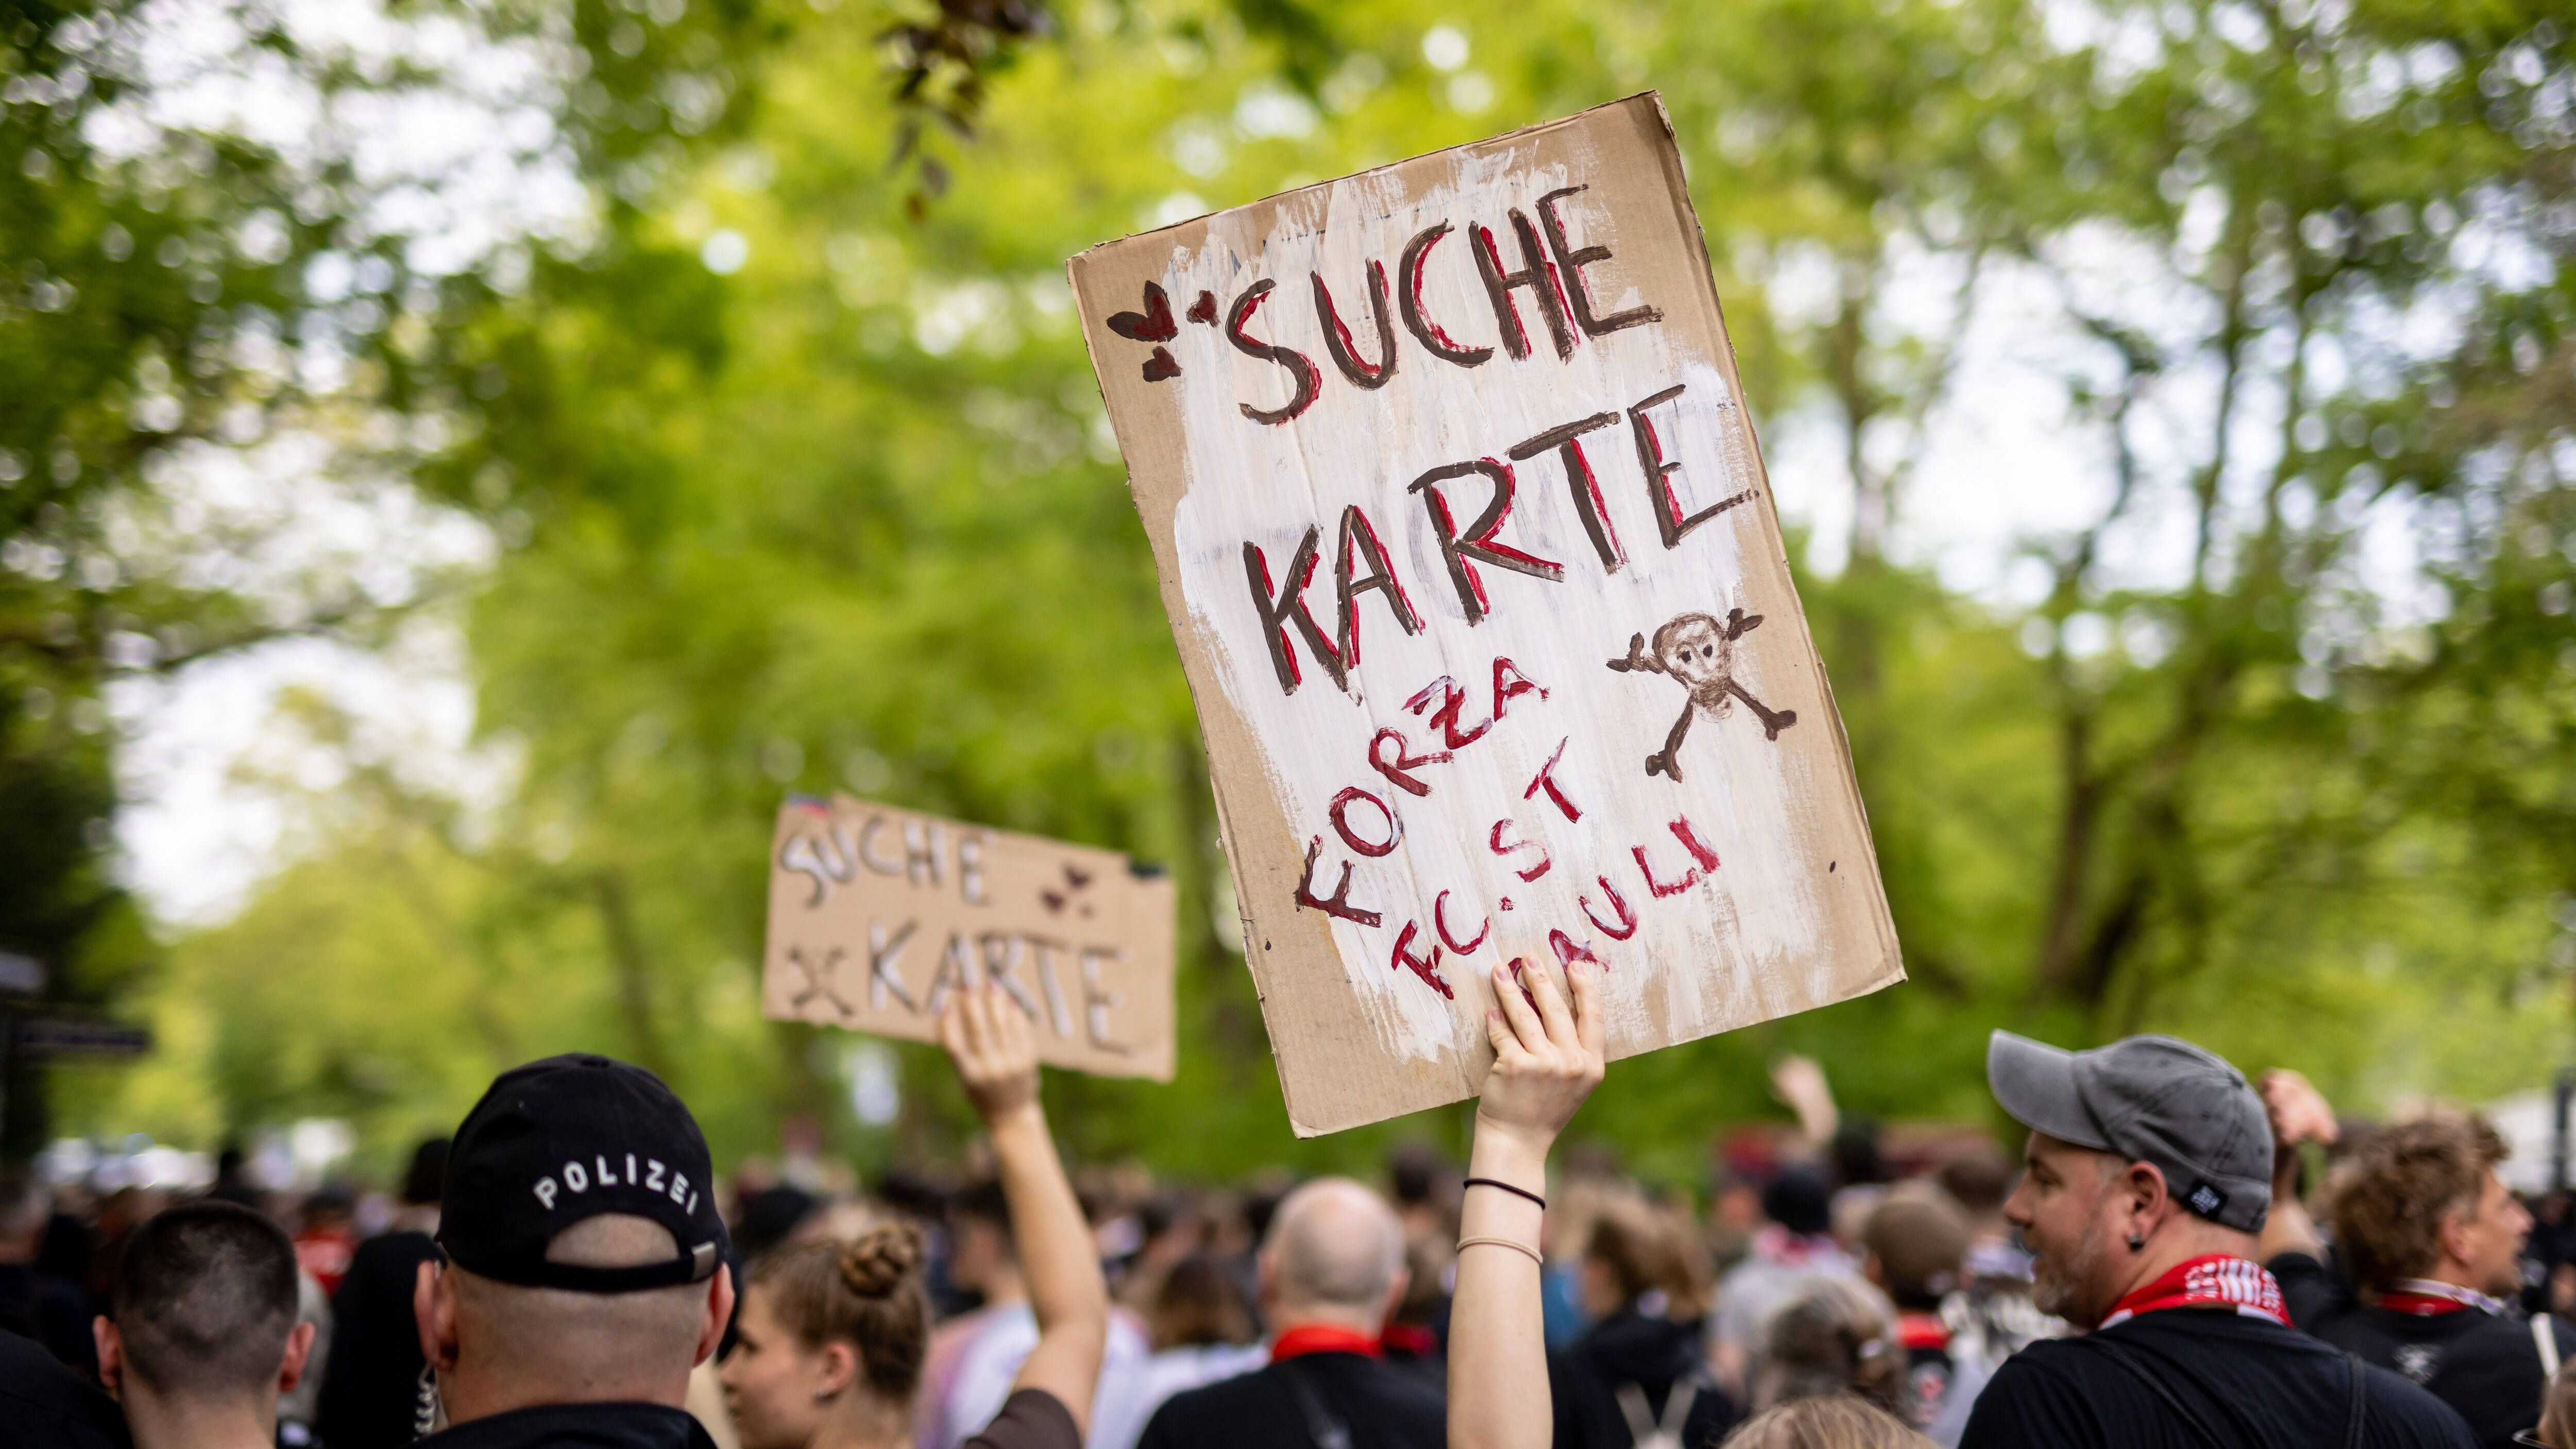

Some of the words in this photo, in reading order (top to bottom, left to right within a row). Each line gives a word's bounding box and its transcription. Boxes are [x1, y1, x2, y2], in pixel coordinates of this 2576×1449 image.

[1226, 184, 1664, 425] SUCHE
[1242, 384, 1760, 700] KARTE
[779, 814, 997, 908] SUCHE
[1295, 656, 1549, 928] FORZA
[868, 920, 1133, 1056] KARTE
[533, 1153, 699, 1215] POLIZEI
